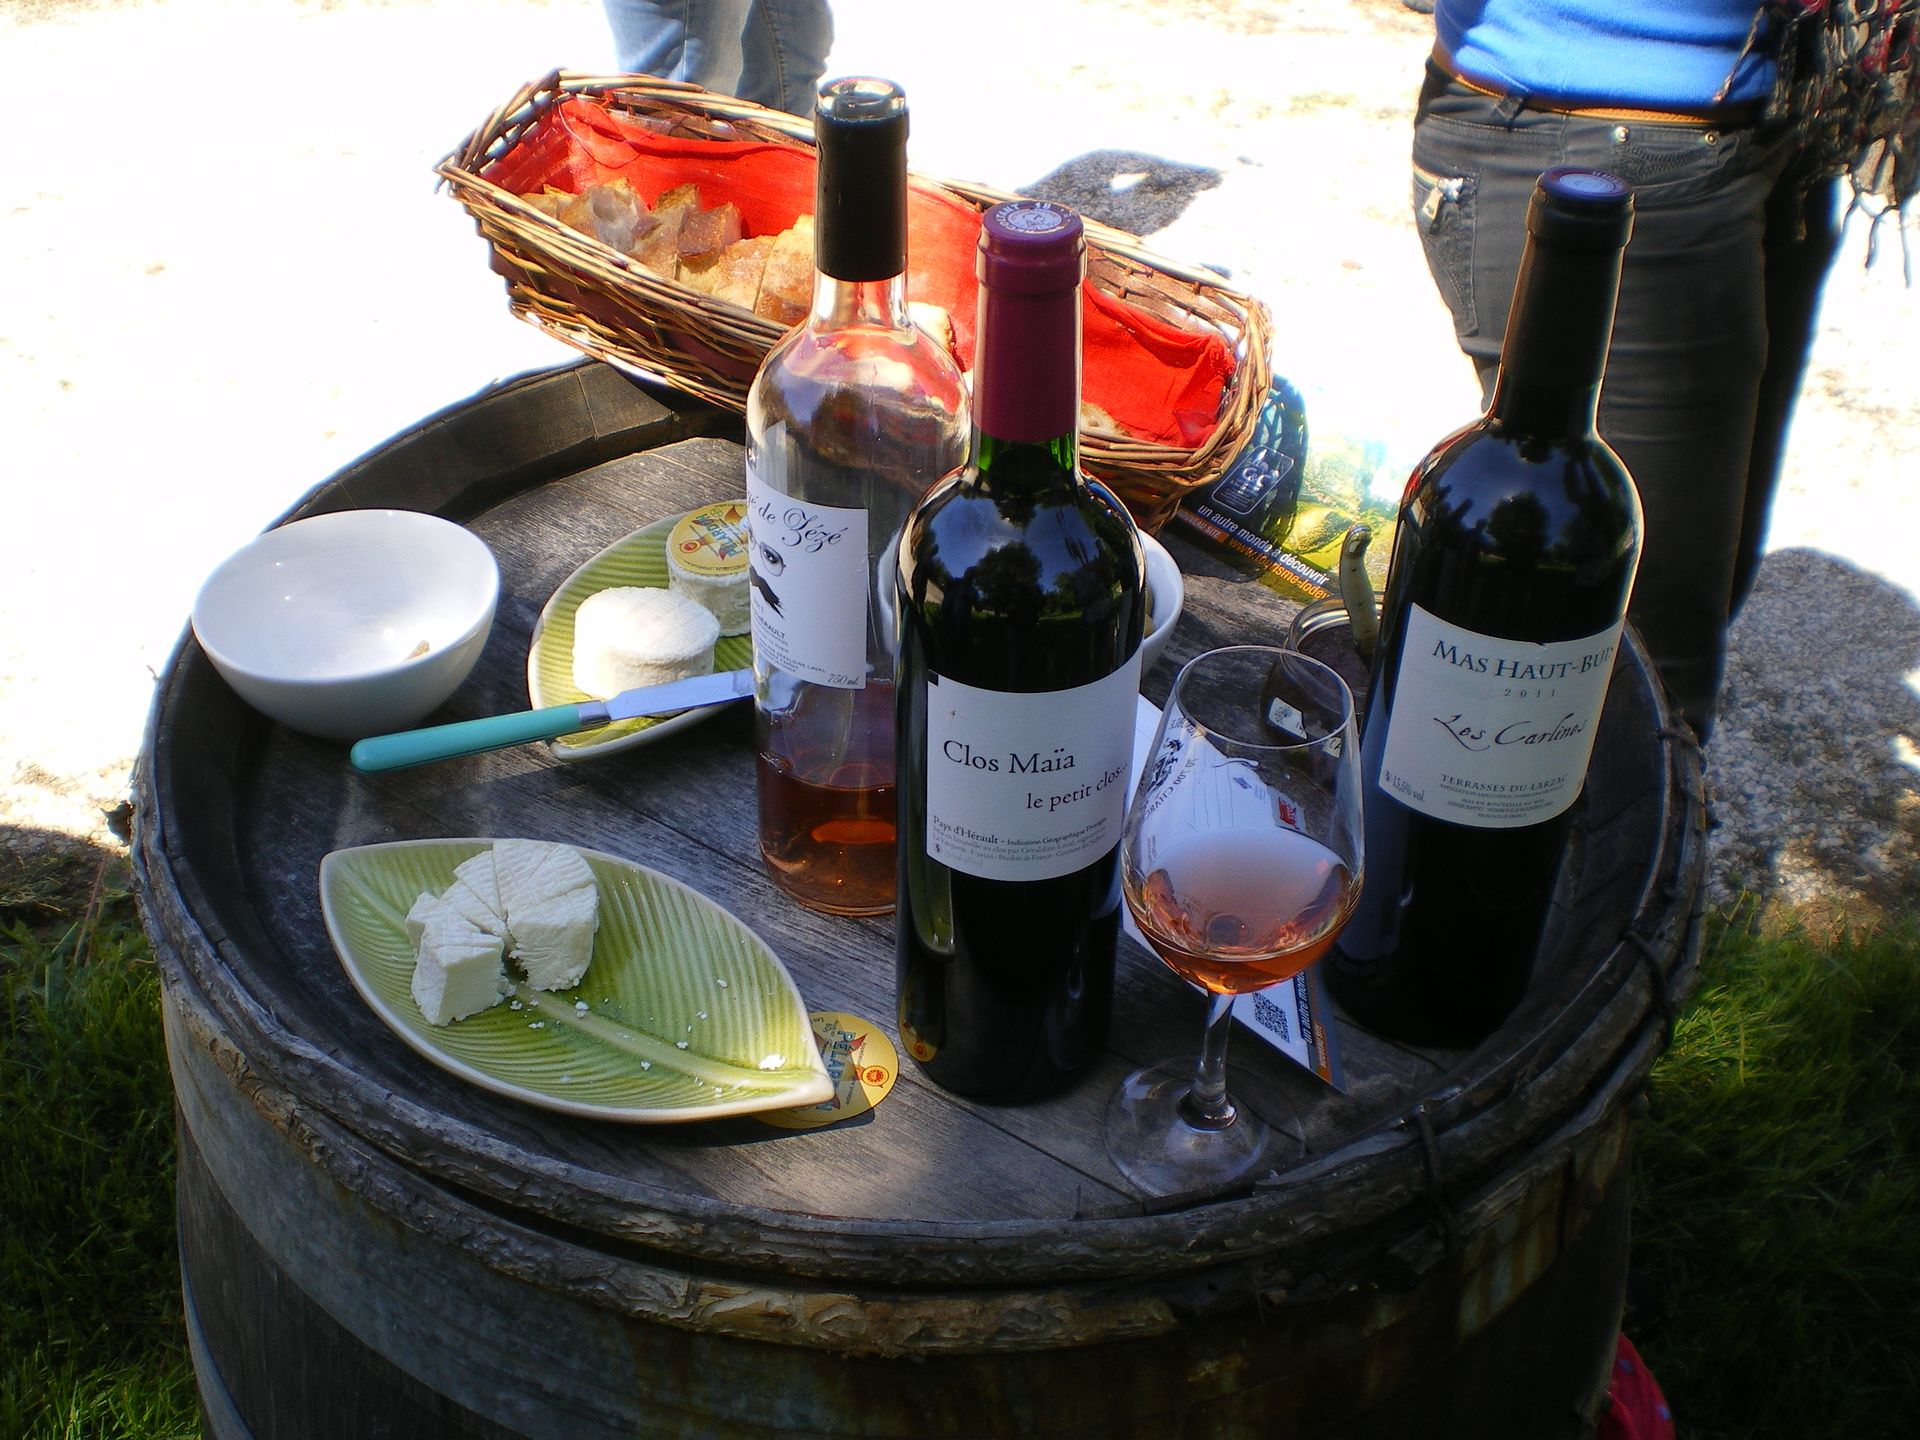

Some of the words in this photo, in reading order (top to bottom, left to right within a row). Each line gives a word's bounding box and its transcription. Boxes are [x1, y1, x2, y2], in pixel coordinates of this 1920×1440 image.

[758, 502, 777, 525] de
[782, 507, 849, 554] Zézé
[1197, 504, 1214, 518] un
[1211, 512, 1239, 533] autre
[1239, 528, 1273, 553] monde
[1280, 552, 1331, 585] découvrir
[1432, 639, 1489, 674] MAS
[827, 672, 848, 685] 750
[1504, 687, 1557, 699] 2011
[1432, 712, 1491, 753] Les
[1494, 711, 1590, 748] Carlines
[943, 739, 1000, 773] Clos
[1008, 747, 1076, 775] Maïa
[1026, 793, 1043, 810] le
[1049, 783, 1092, 812] petit
[1441, 773, 1506, 793] TERRASSES
[1510, 783, 1528, 793] DU
[933, 815, 952, 832] Pays
[953, 825, 999, 844] d'Hérault
[1299, 1001, 1311, 1028] autre
